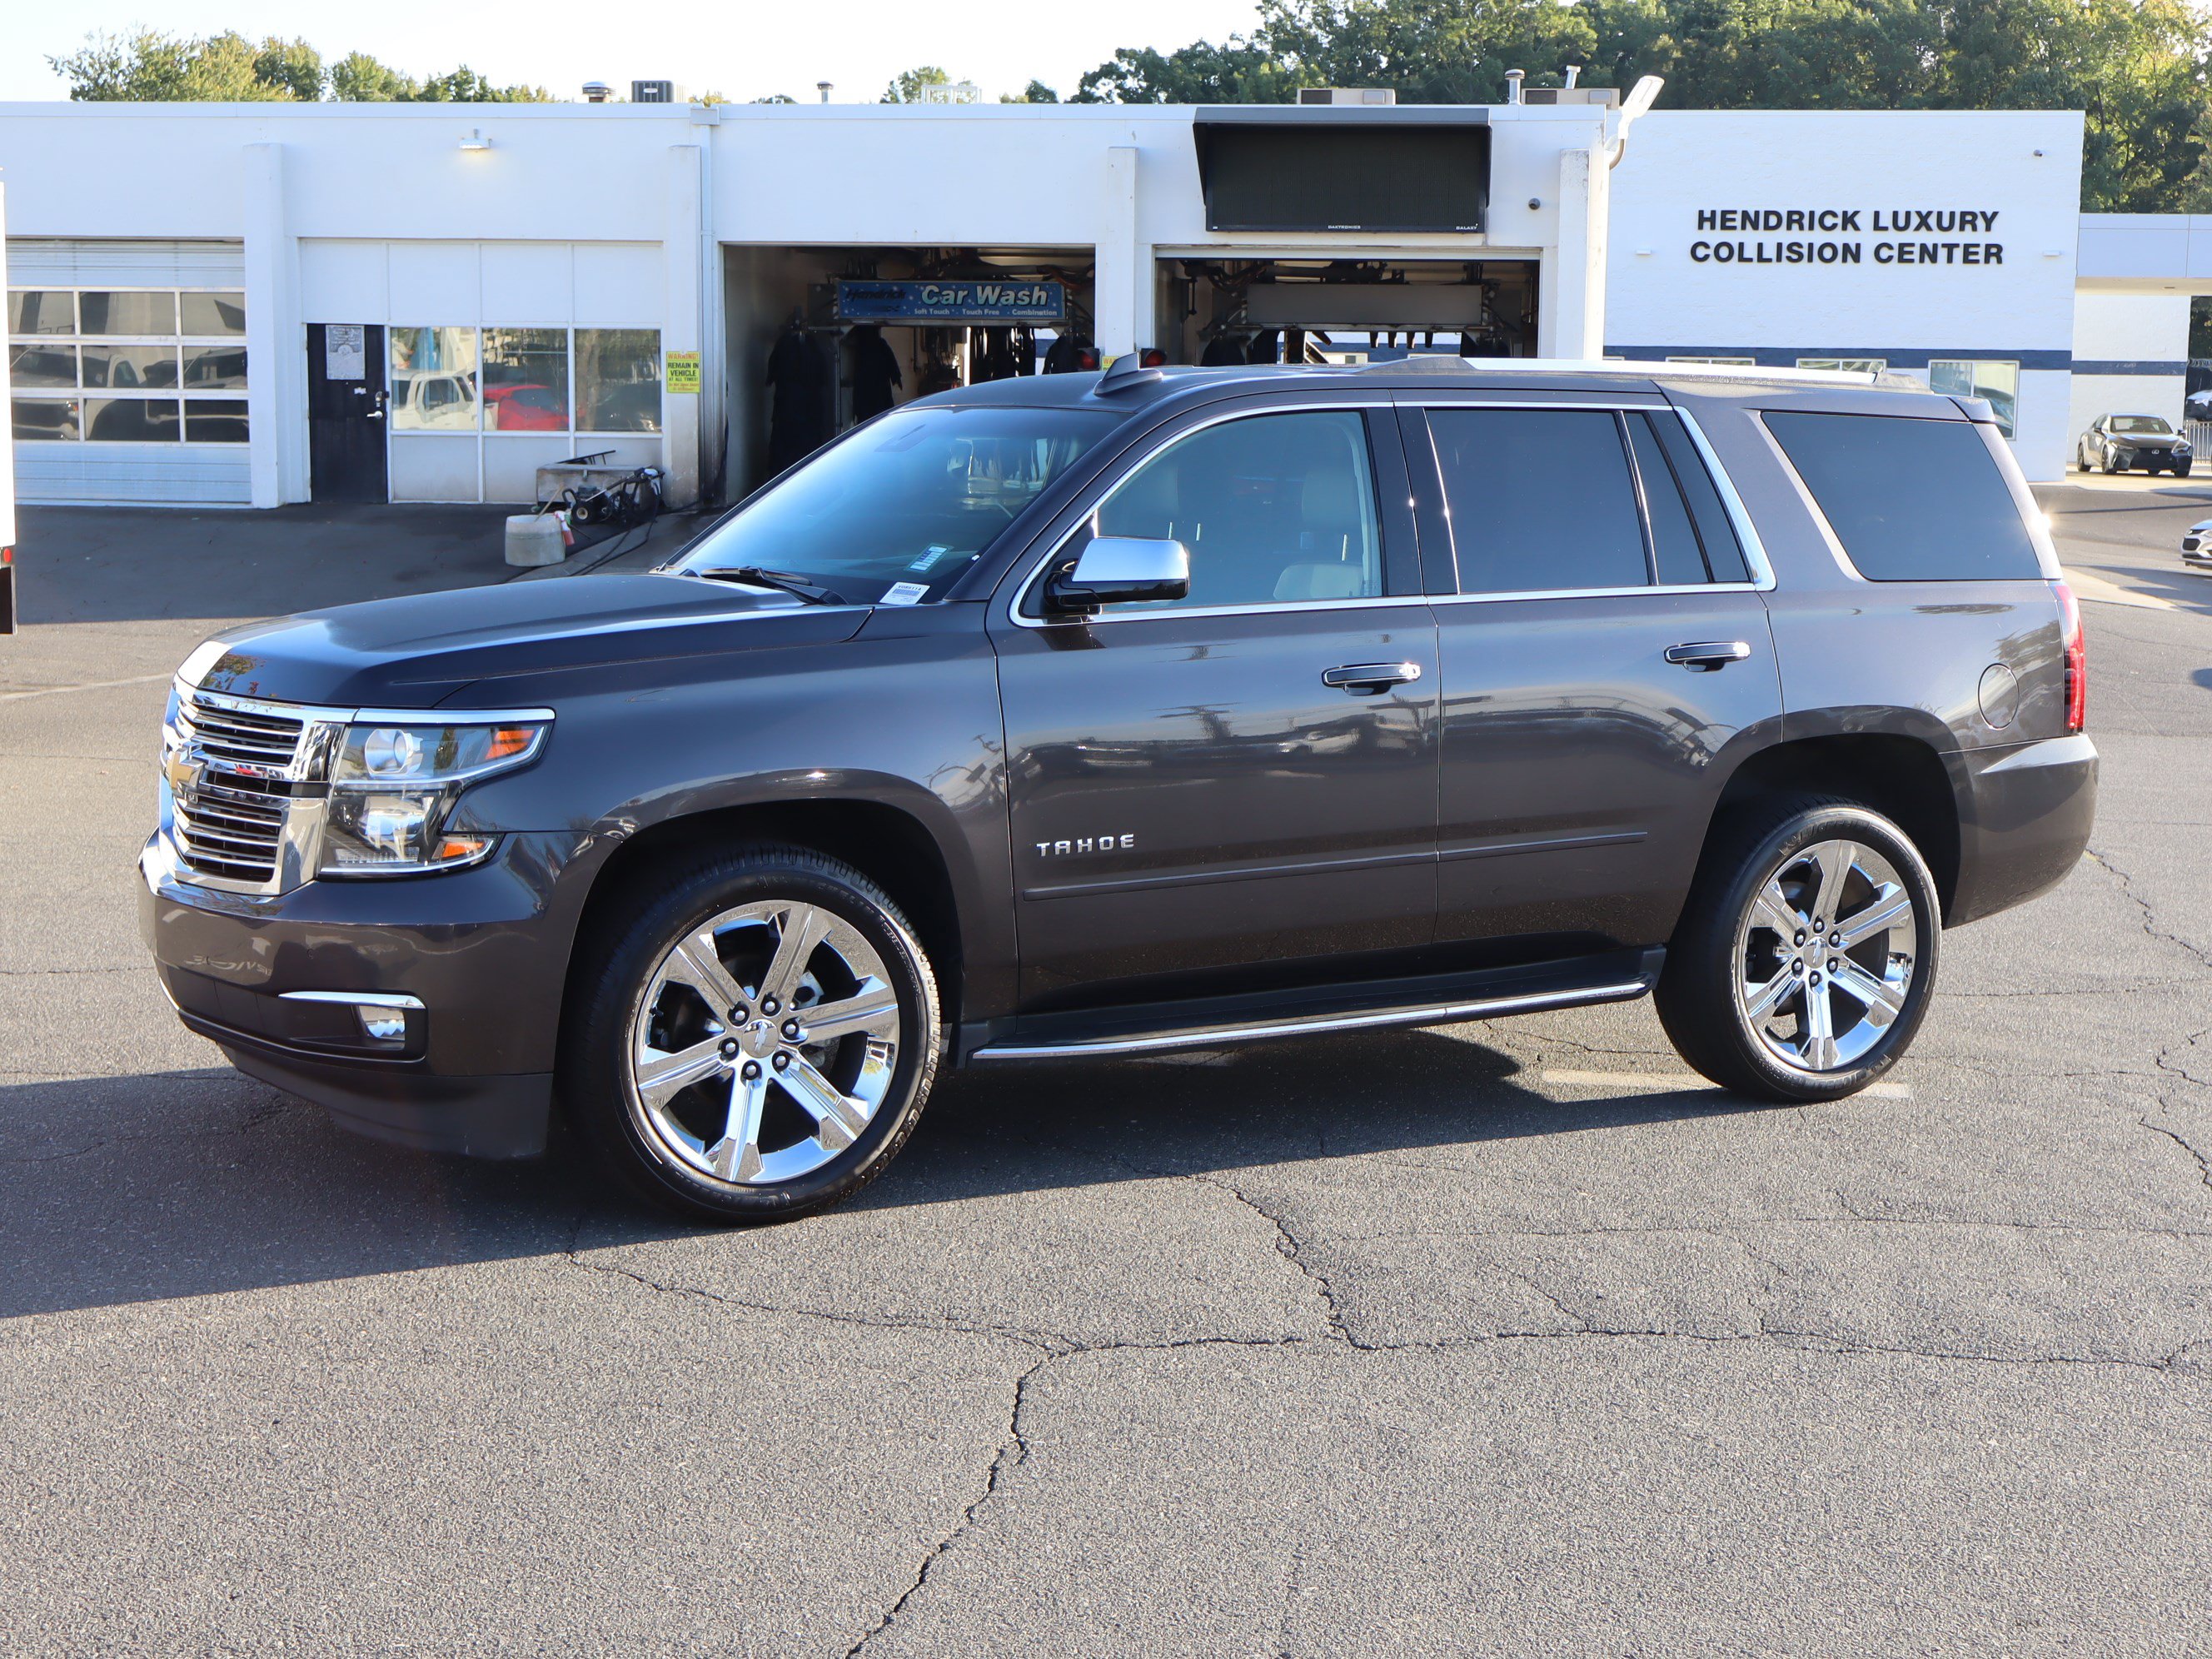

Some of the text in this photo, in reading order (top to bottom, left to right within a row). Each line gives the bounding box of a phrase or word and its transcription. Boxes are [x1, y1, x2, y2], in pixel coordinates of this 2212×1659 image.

[1697, 210, 2000, 232] HENDRICK LUXURY
[1690, 242, 2003, 264] COLLISION CENTER
[921, 285, 1048, 306] Car Wash
[1036, 833, 1134, 857] TAHOE
